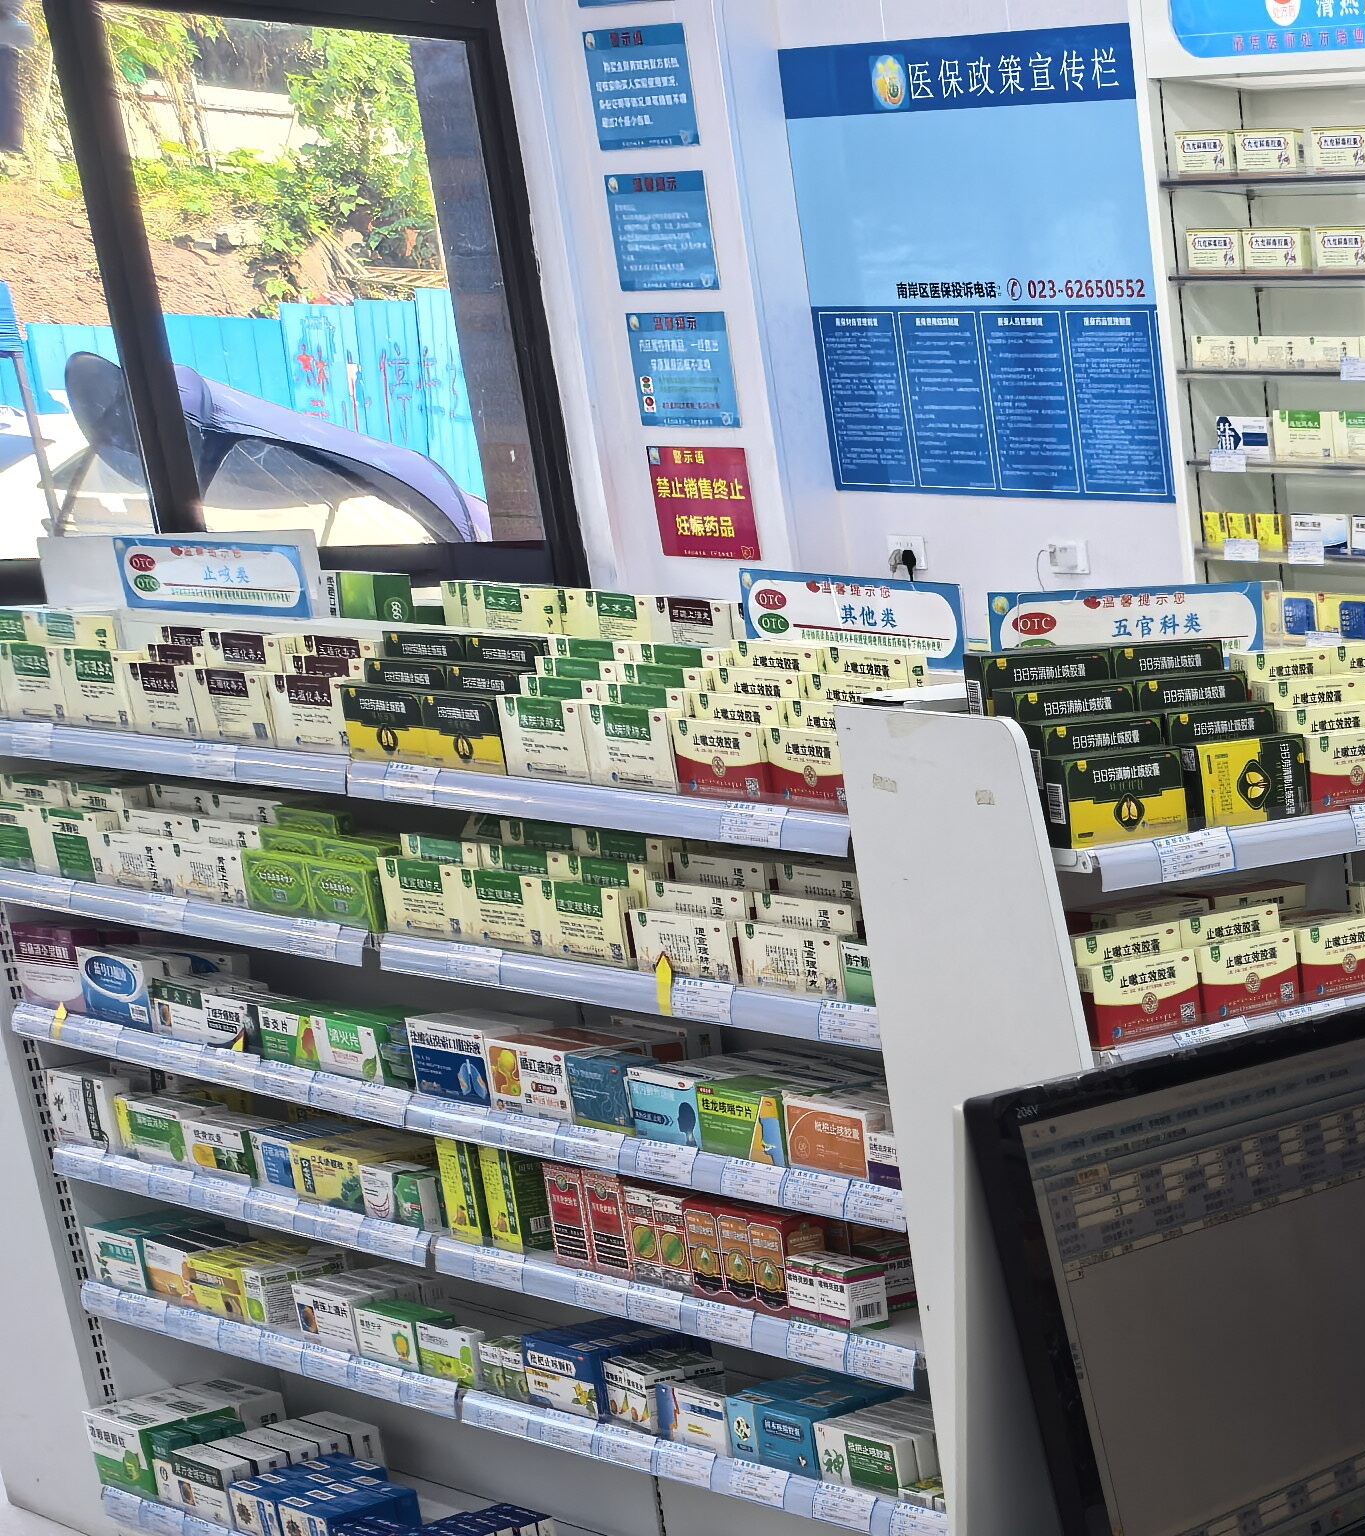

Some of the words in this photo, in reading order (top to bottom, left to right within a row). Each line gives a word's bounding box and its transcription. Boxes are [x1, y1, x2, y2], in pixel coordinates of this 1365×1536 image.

[908, 47, 1119, 100] 医保政策宣传栏
[1027, 279, 1146, 299] 023-62650552
[672, 449, 705, 465] 警示语
[656, 476, 746, 500] 禁止销售终止
[676, 514, 735, 538] 妊娠药品
[132, 558, 156, 569] OTC
[203, 565, 250, 584] 止咳类
[137, 577, 160, 589] OTC
[820, 581, 891, 599] 温馨提示您
[758, 594, 782, 606] OTC
[1102, 593, 1185, 609] 温馨提示您
[762, 617, 785, 630] OTC
[840, 605, 898, 628] 其他类
[1020, 617, 1051, 631] OTC
[1112, 612, 1202, 638] 五官科类
[1269, 662, 1314, 677] 止嗽立效胶囊
[1293, 690, 1342, 705] 止嗽立效胶囊
[1311, 716, 1360, 732] 止嗽立效胶囊
[1206, 915, 1260, 941] 止嗽立效胶囊
[844, 952, 870, 968] 肺宁颗
[701, 1099, 753, 1119] 桂龙咳喘宁片
